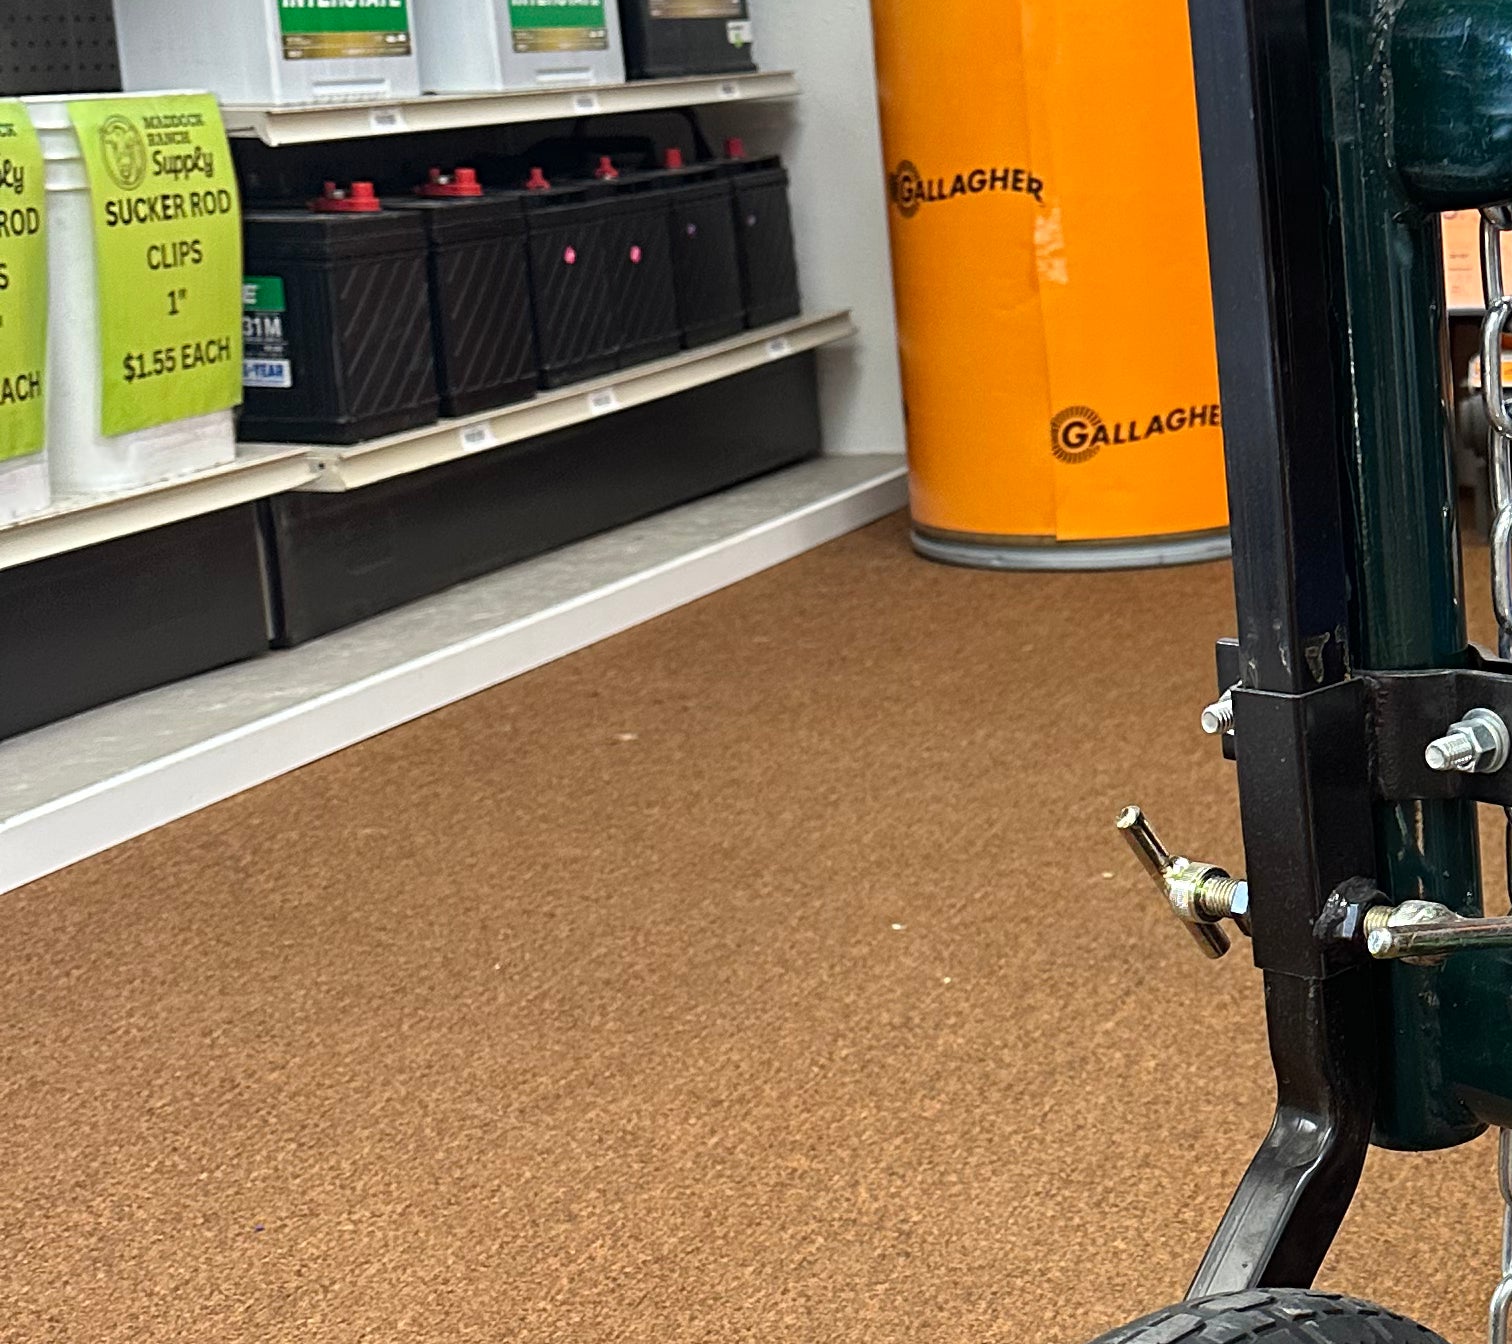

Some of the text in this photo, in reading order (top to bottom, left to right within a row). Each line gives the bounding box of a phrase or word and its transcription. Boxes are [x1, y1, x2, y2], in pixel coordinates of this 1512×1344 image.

[151, 146, 214, 177] Supply
[900, 167, 1045, 206] GALLAGHER
[105, 189, 231, 227] SUCKER ROD
[146, 239, 203, 271] CLIPS
[167, 289, 187, 316] 1"
[123, 338, 230, 384] $1.55 EACH
